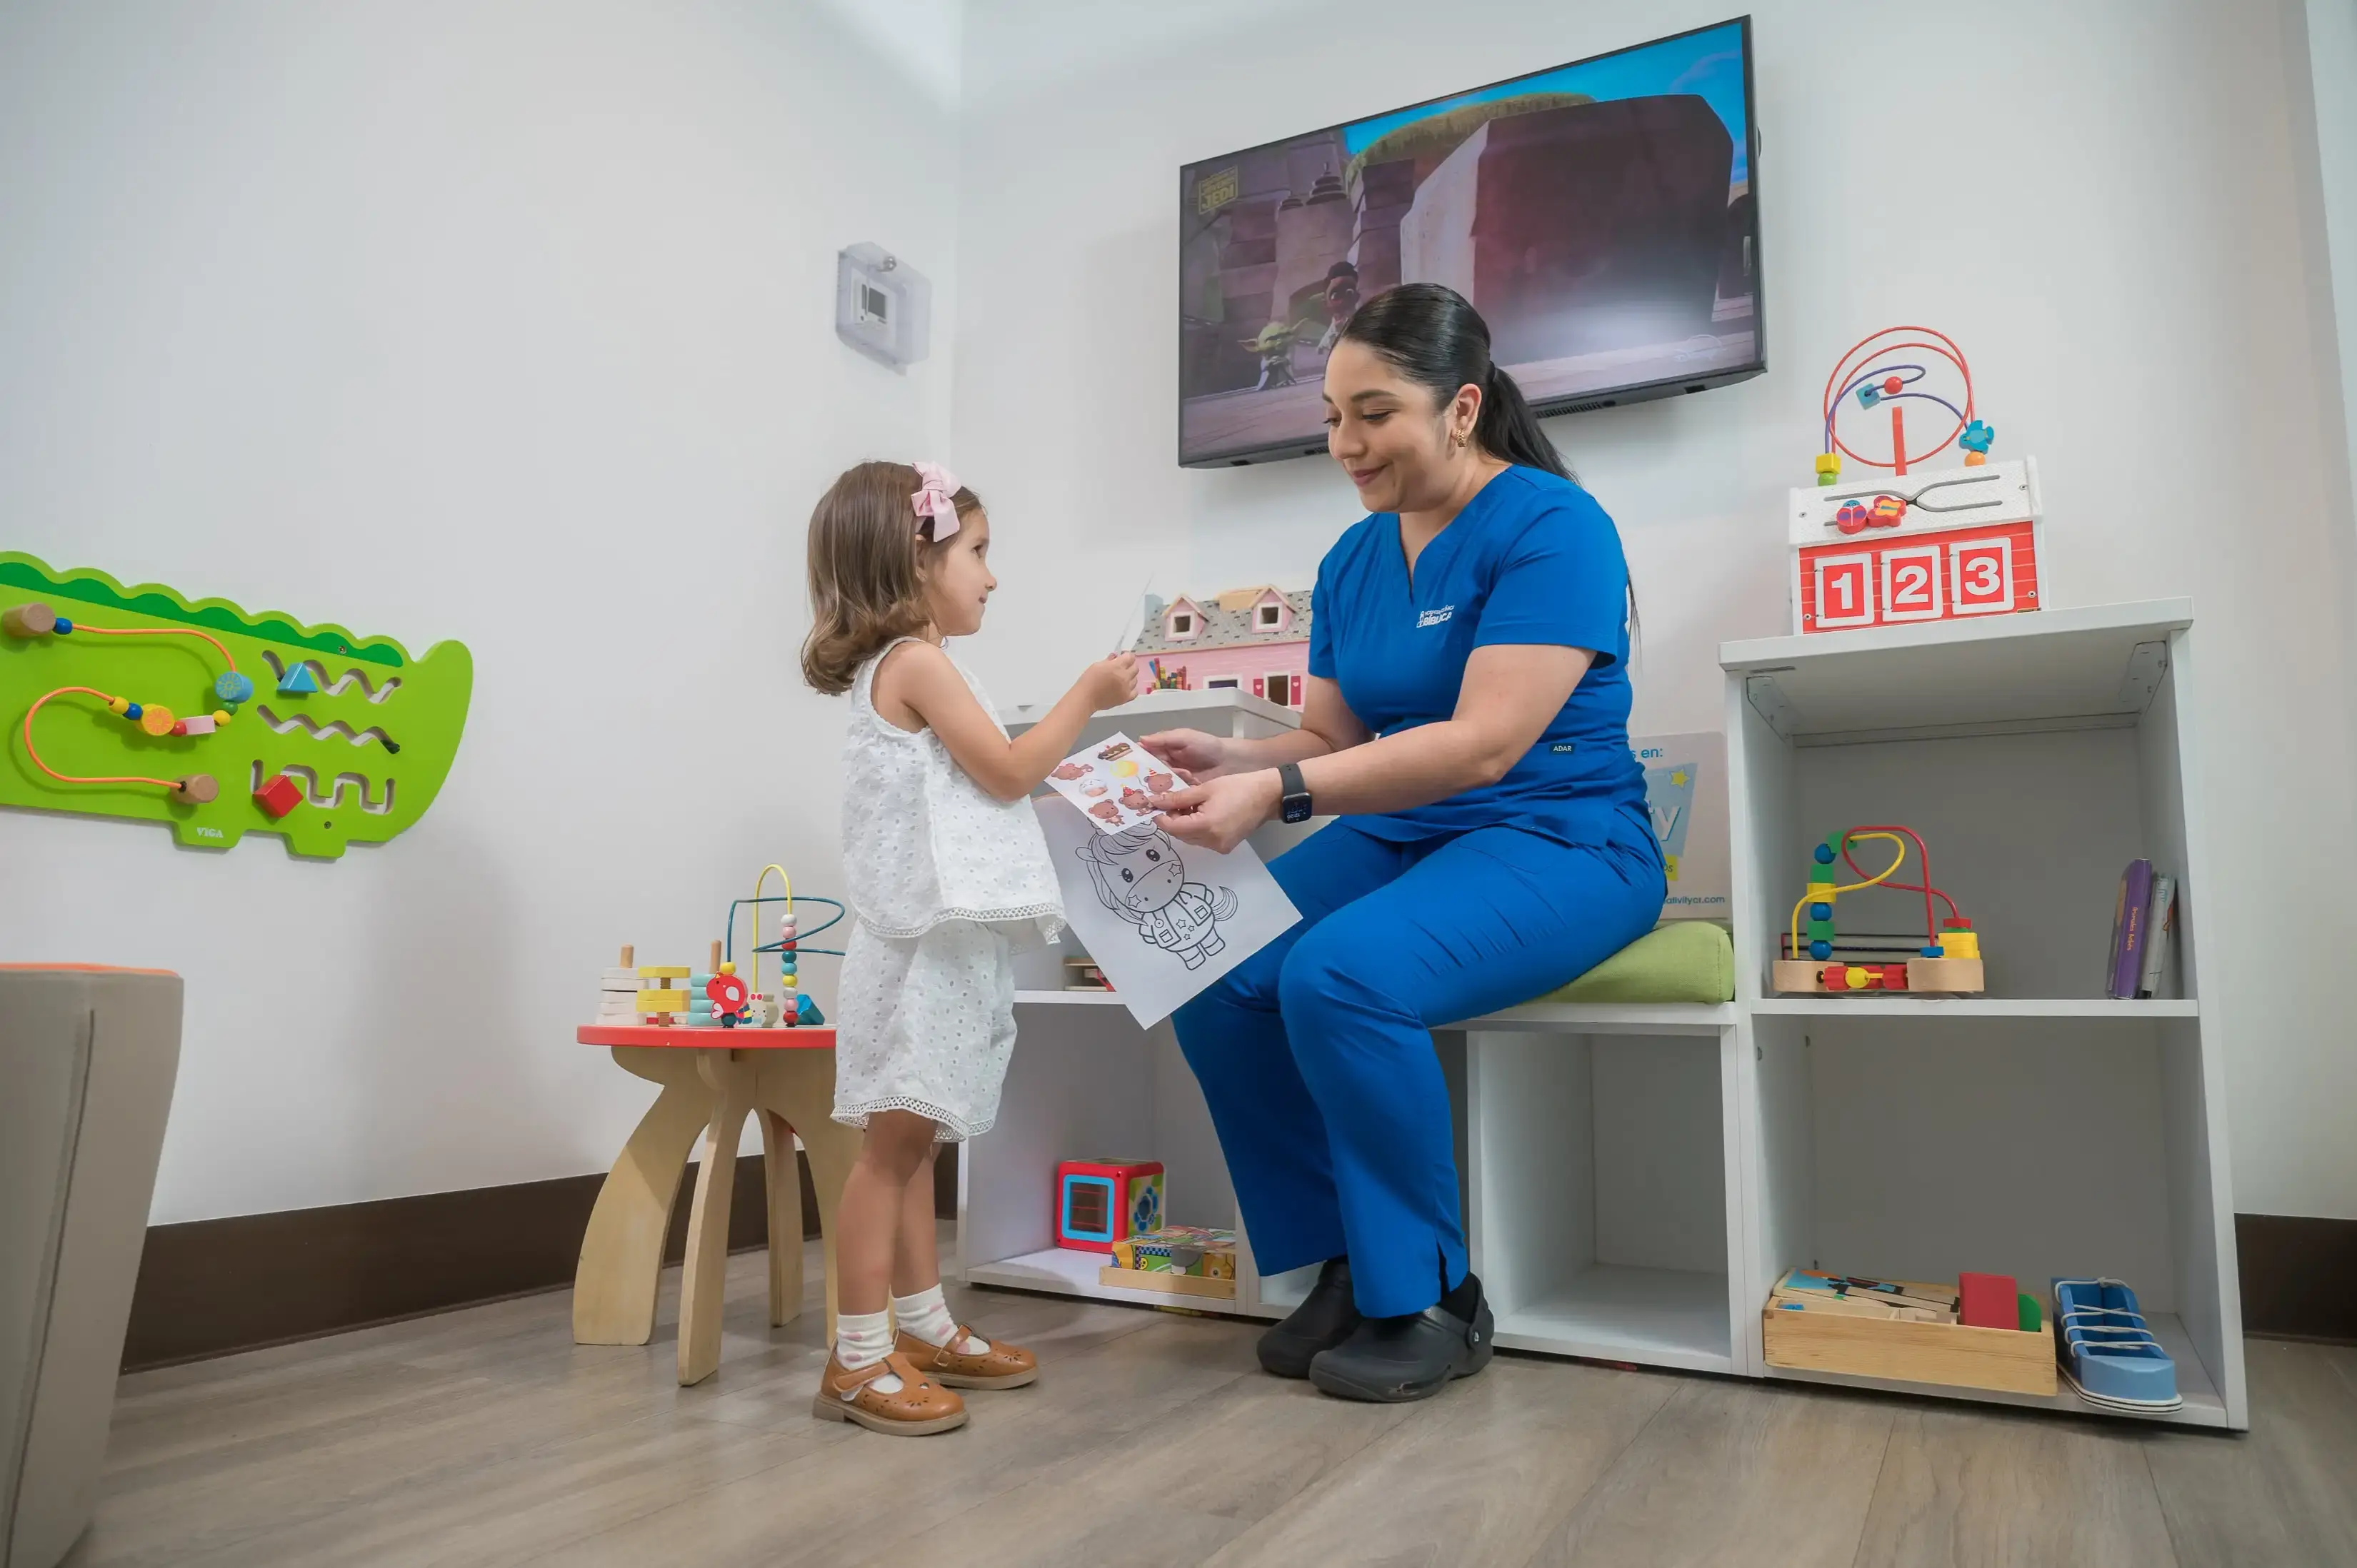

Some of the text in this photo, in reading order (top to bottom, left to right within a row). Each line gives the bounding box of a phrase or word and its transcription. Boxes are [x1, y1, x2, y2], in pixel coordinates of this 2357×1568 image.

[1201, 184, 1235, 209] JEDI
[1831, 556, 2001, 610] 1 2 3
[1641, 748, 1663, 758] en:
[196, 827, 224, 838] VIGA
